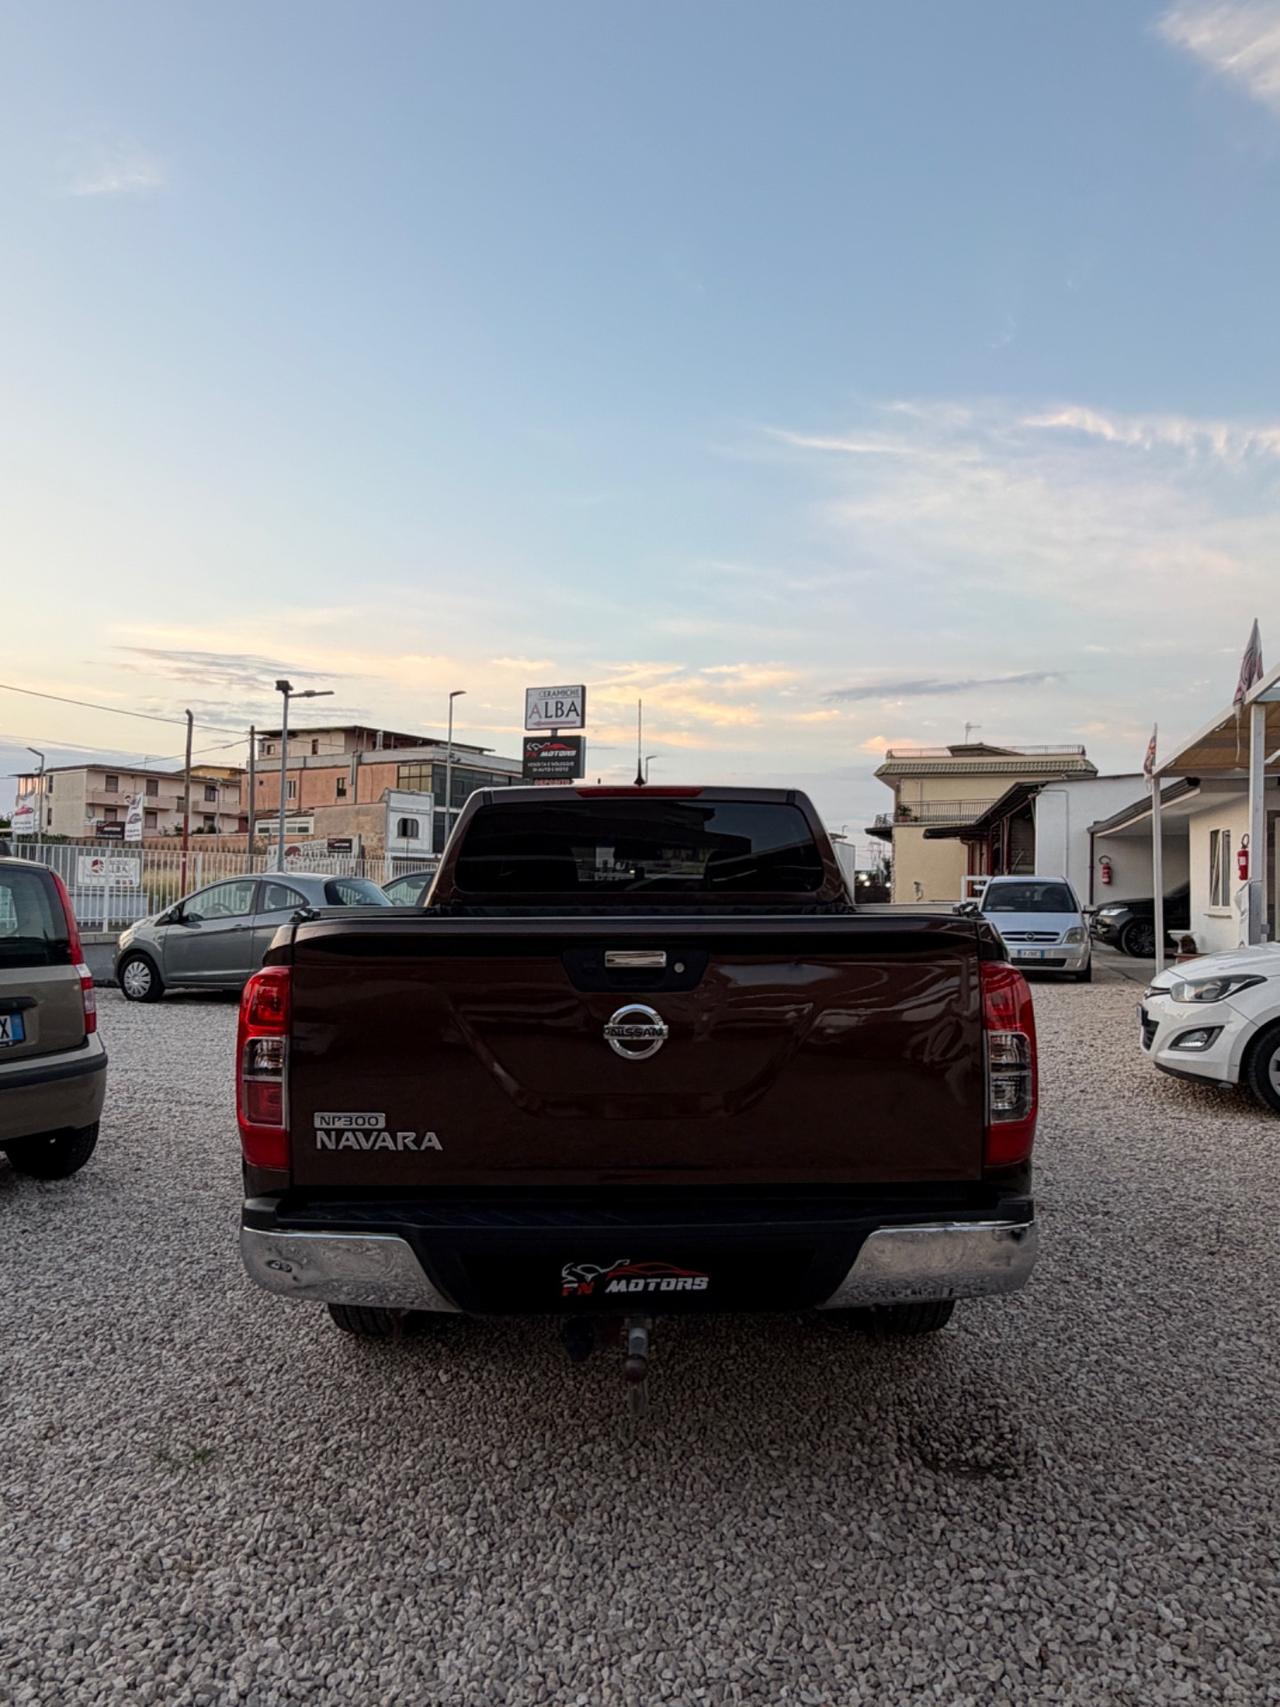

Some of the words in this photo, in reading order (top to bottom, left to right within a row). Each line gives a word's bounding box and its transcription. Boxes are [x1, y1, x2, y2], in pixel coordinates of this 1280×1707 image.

[538, 688, 580, 698] CERAMICHE
[528, 700, 580, 719] ALBA
[610, 1027, 664, 1037] NISSAN
[319, 1115, 379, 1127] NP300
[316, 1130, 443, 1151] NAVARA
[605, 1277, 710, 1293] MOTORS
